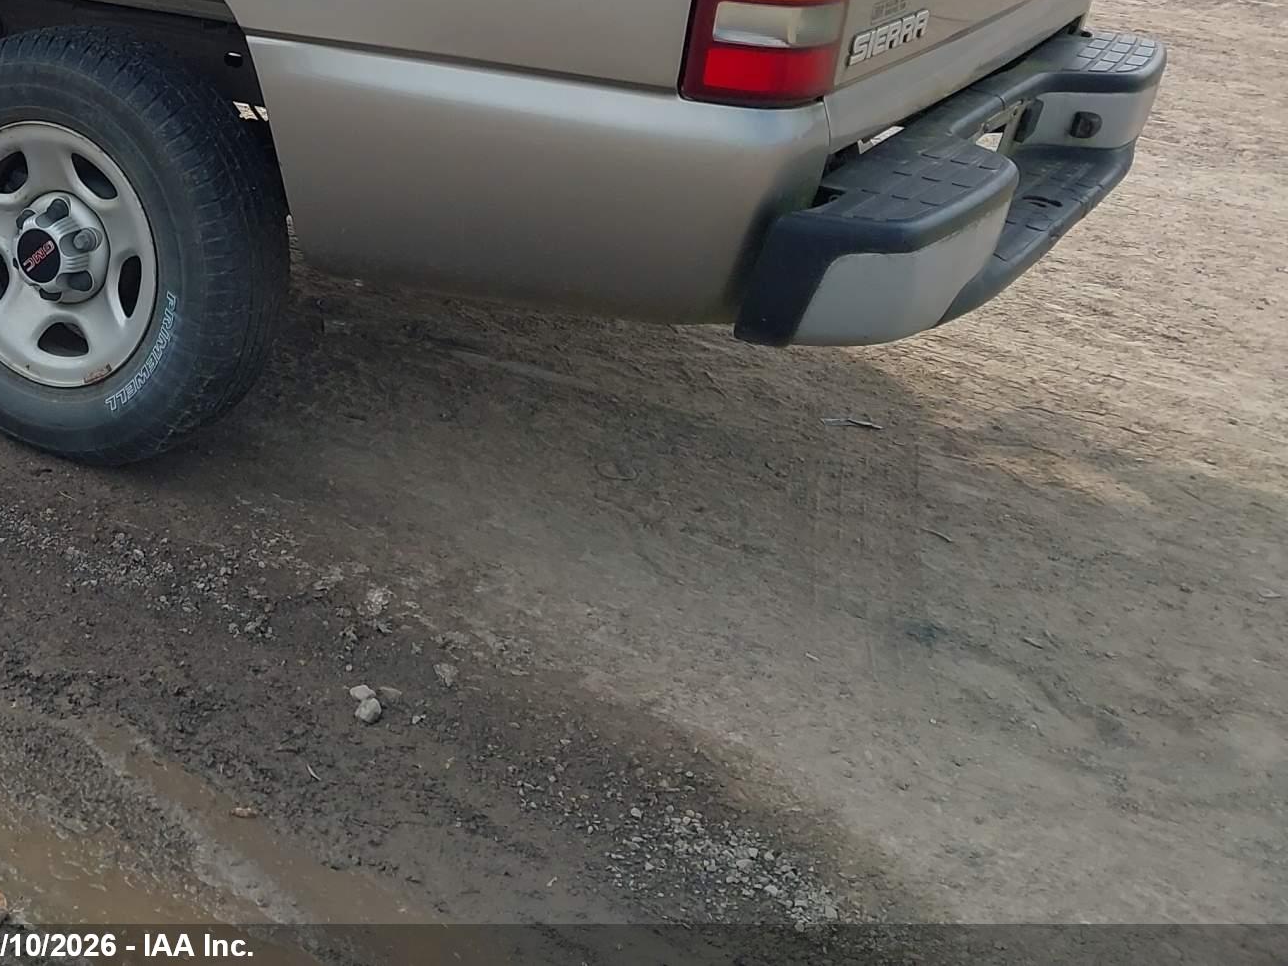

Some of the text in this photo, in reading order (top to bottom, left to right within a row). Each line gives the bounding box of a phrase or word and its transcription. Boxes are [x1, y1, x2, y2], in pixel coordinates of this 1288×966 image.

[846, 8, 930, 67] SIERRA
[22, 240, 55, 273] GMC
[104, 290, 177, 411] PRIMEWELL
